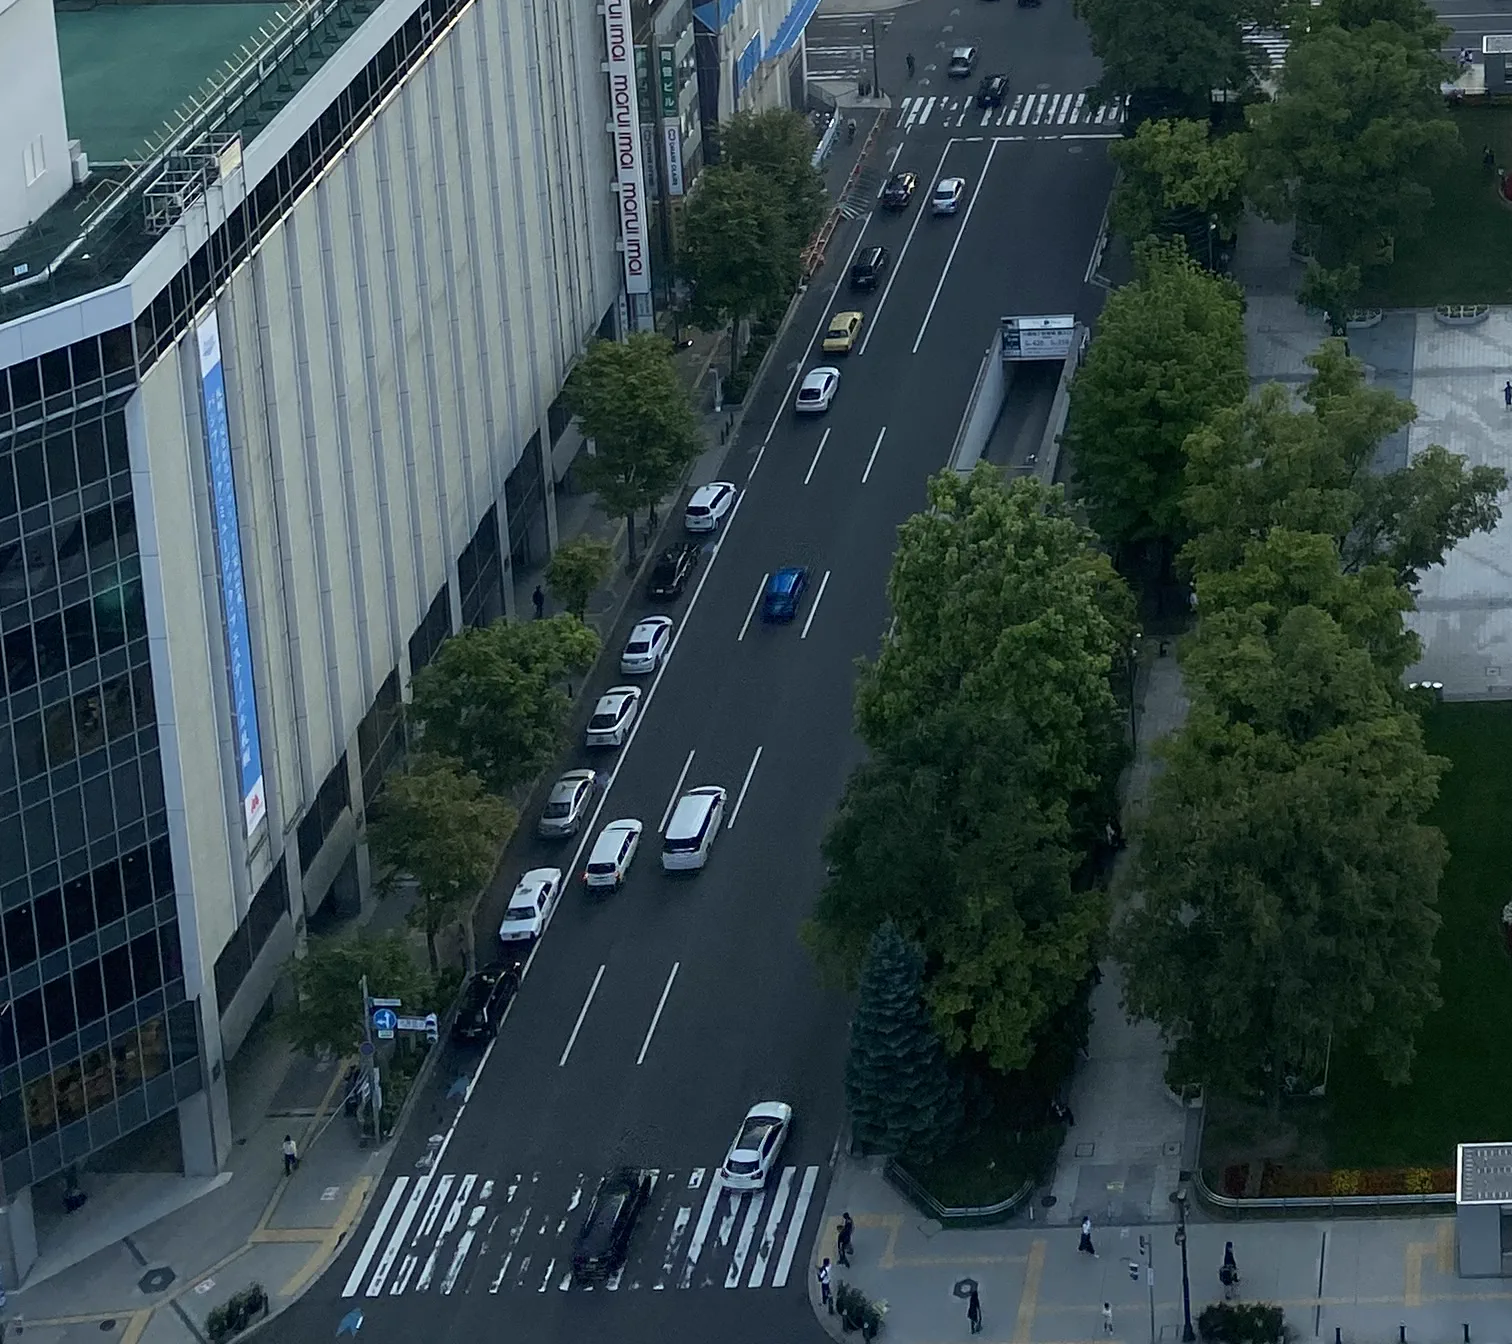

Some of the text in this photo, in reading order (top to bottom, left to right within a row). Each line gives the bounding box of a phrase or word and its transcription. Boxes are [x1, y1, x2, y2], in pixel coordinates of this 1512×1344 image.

[610, 24, 626, 62] imai
[614, 75, 633, 169] marui imai
[621, 183, 642, 275] marui imai
